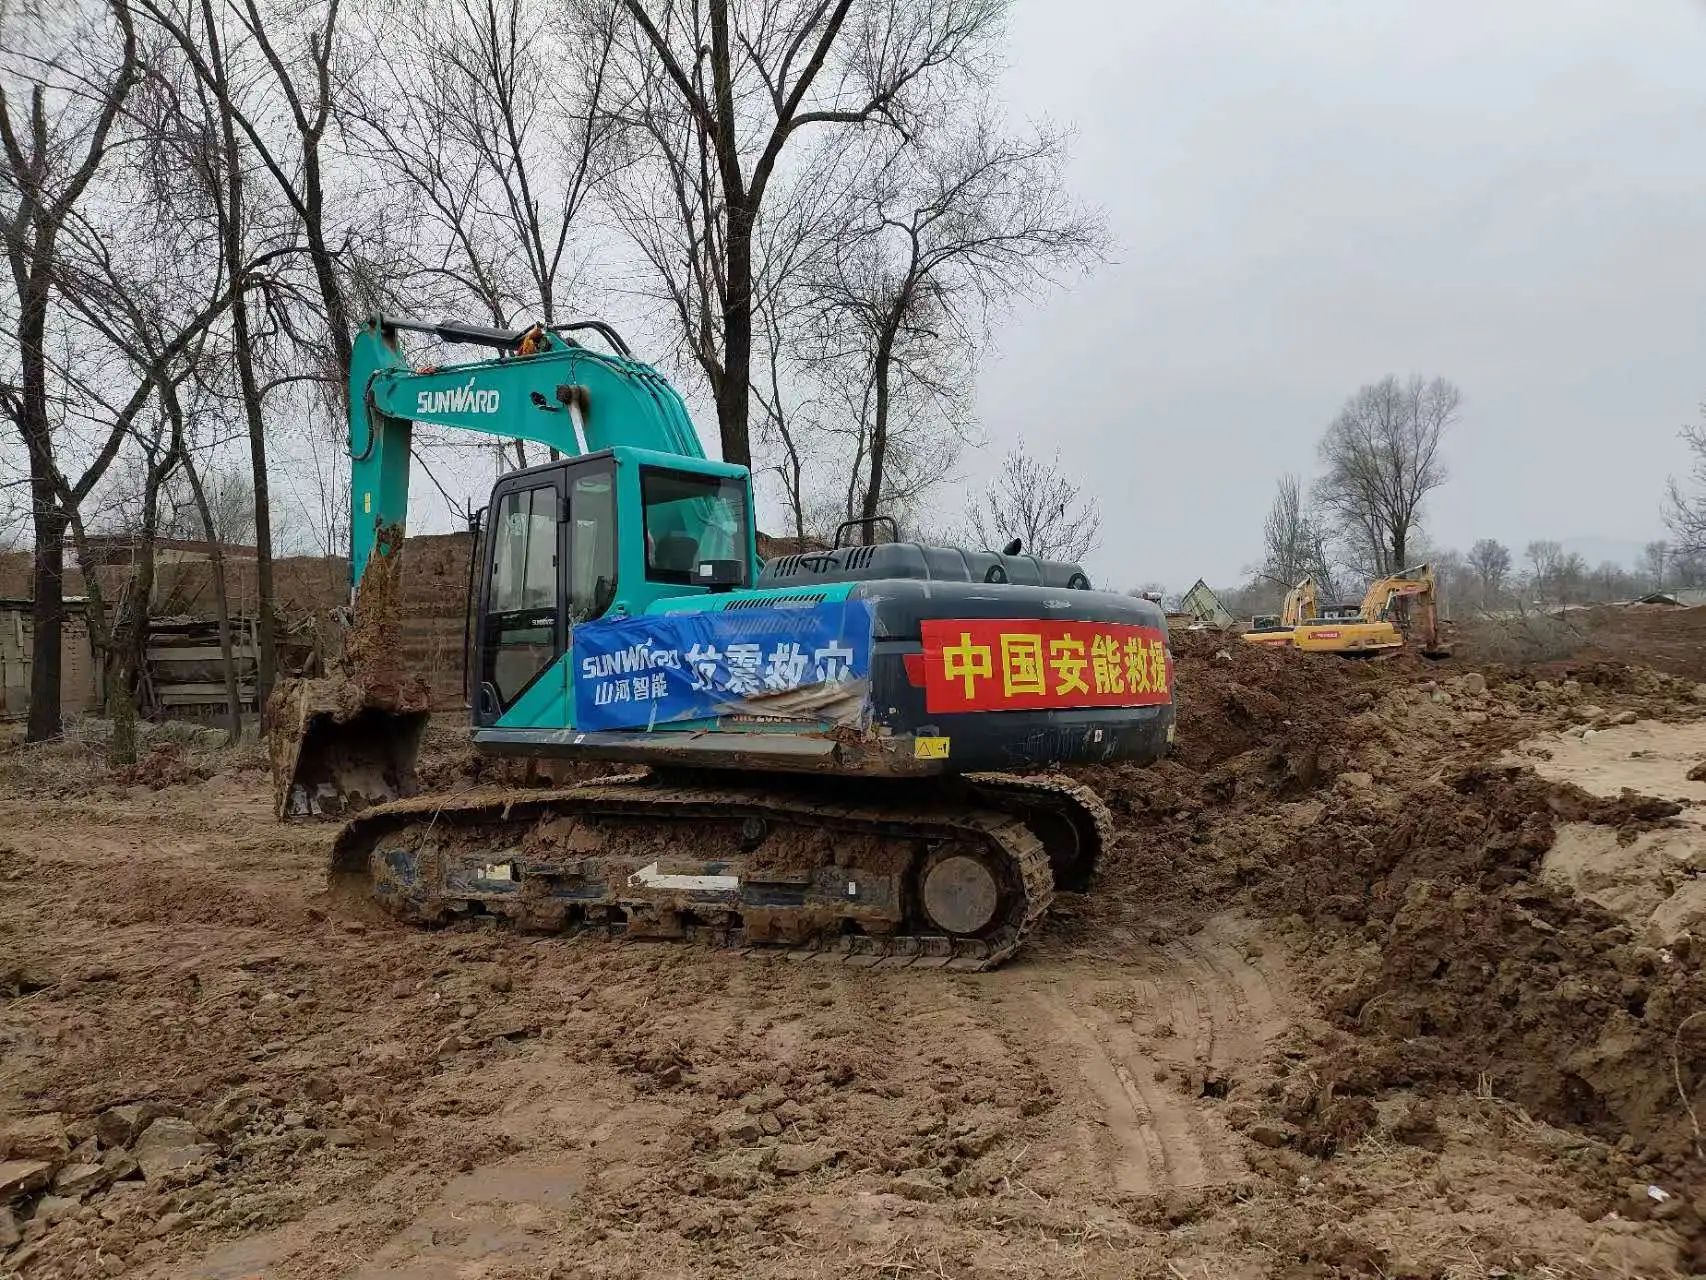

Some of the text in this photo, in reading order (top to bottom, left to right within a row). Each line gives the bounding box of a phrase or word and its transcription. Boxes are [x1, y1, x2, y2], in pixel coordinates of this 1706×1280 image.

[416, 377, 500, 414] SUNWARD
[942, 632, 1168, 700] 中国安能救援
[595, 672, 669, 706] 山河智能
